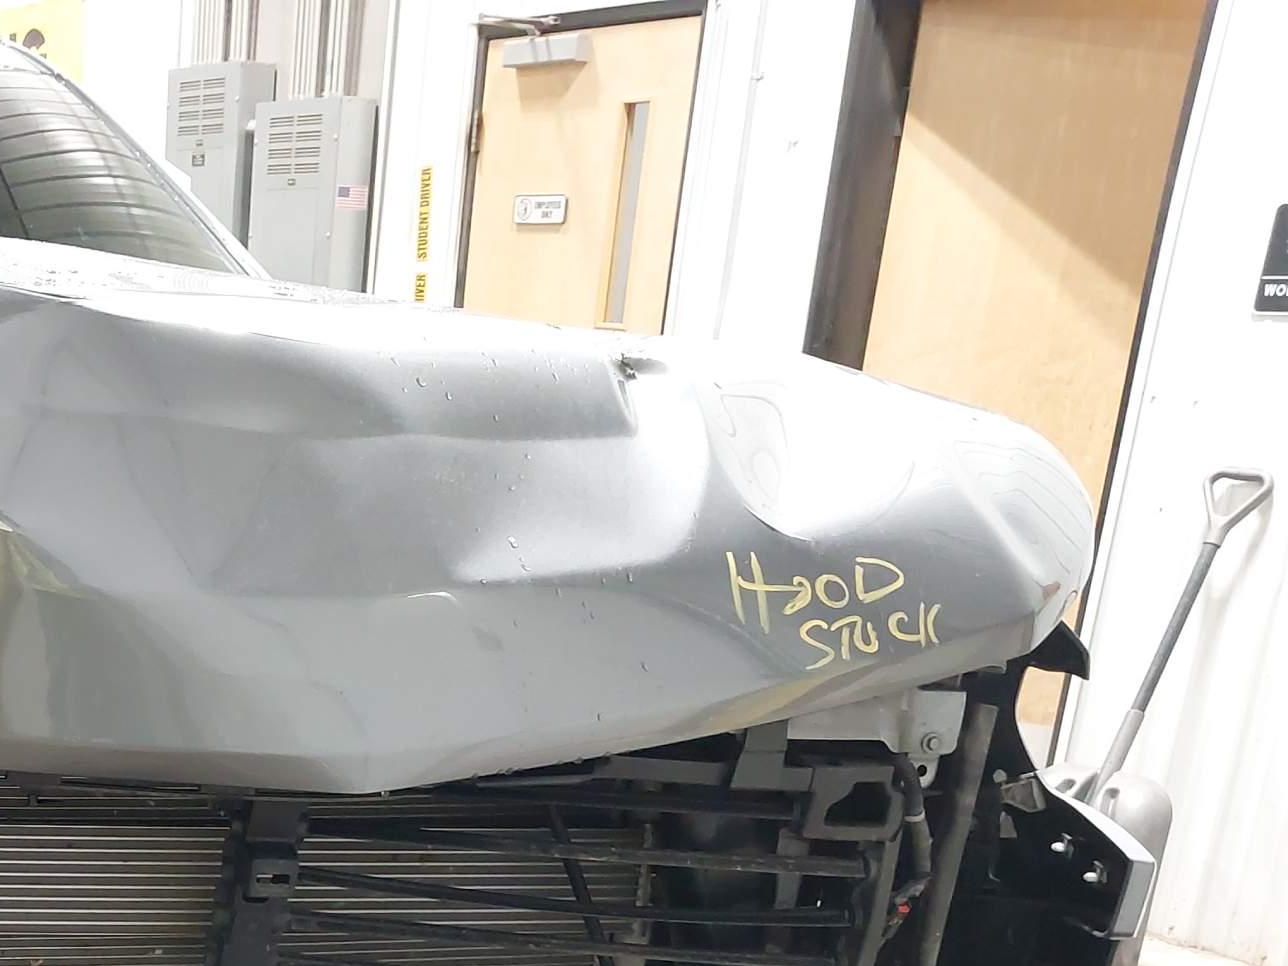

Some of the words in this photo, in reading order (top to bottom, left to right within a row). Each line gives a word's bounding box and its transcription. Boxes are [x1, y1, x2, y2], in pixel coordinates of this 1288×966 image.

[420, 167, 432, 208] DRIVER
[417, 211, 429, 260] STUDENT
[1263, 283, 1288, 297] WO
